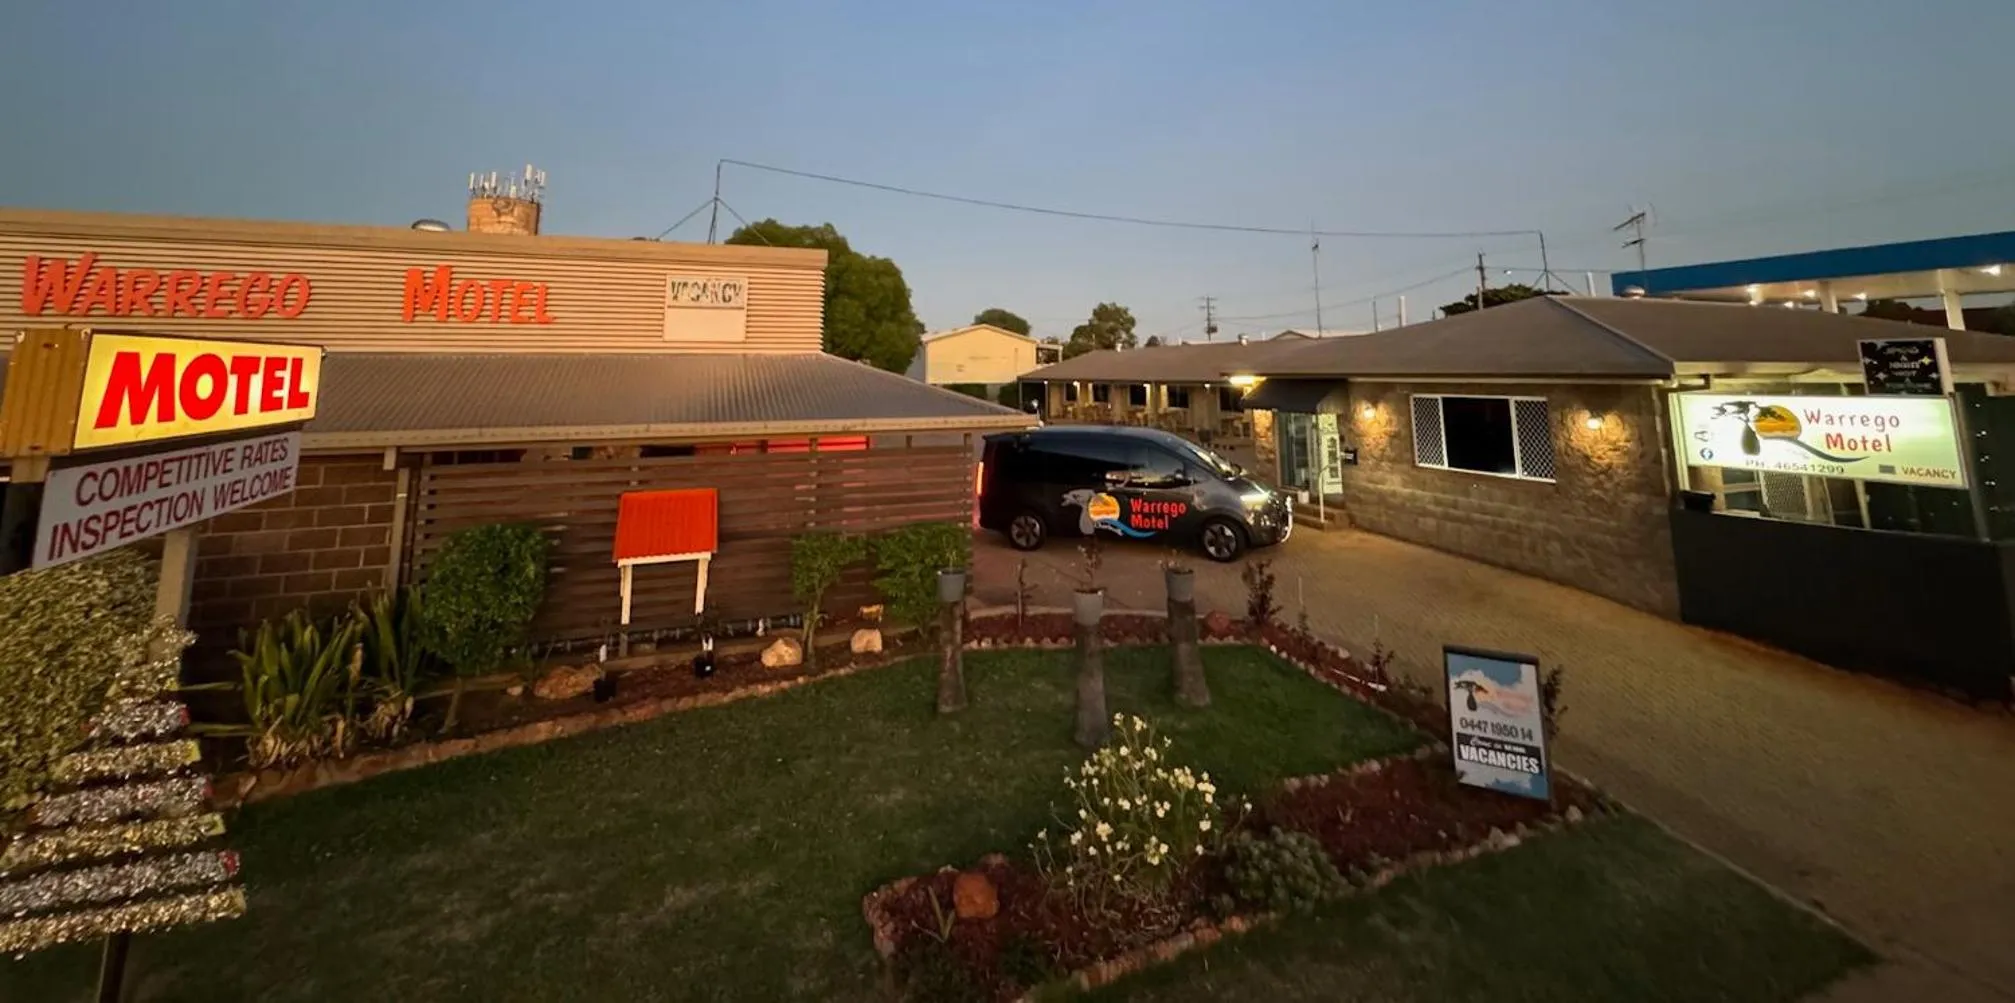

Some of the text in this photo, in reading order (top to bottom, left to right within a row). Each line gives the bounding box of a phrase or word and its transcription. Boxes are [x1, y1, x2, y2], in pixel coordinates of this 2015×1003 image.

[21, 251, 558, 325] WARREGO MOTEL
[93, 351, 310, 430] MOTEL
[1803, 407, 1900, 433] Warrego
[1825, 432, 1892, 453] Motel
[75, 437, 289, 507] COMPETITIVE RATES
[1775, 461, 1845, 475] 46541299
[1901, 466, 1957, 480] VACANCY
[47, 466, 293, 562] INSPECTION WELCOME
[1129, 498, 1187, 518] Warrego
[1130, 514, 1169, 530] Motel
[1460, 743, 1540, 774] VACANCIES
